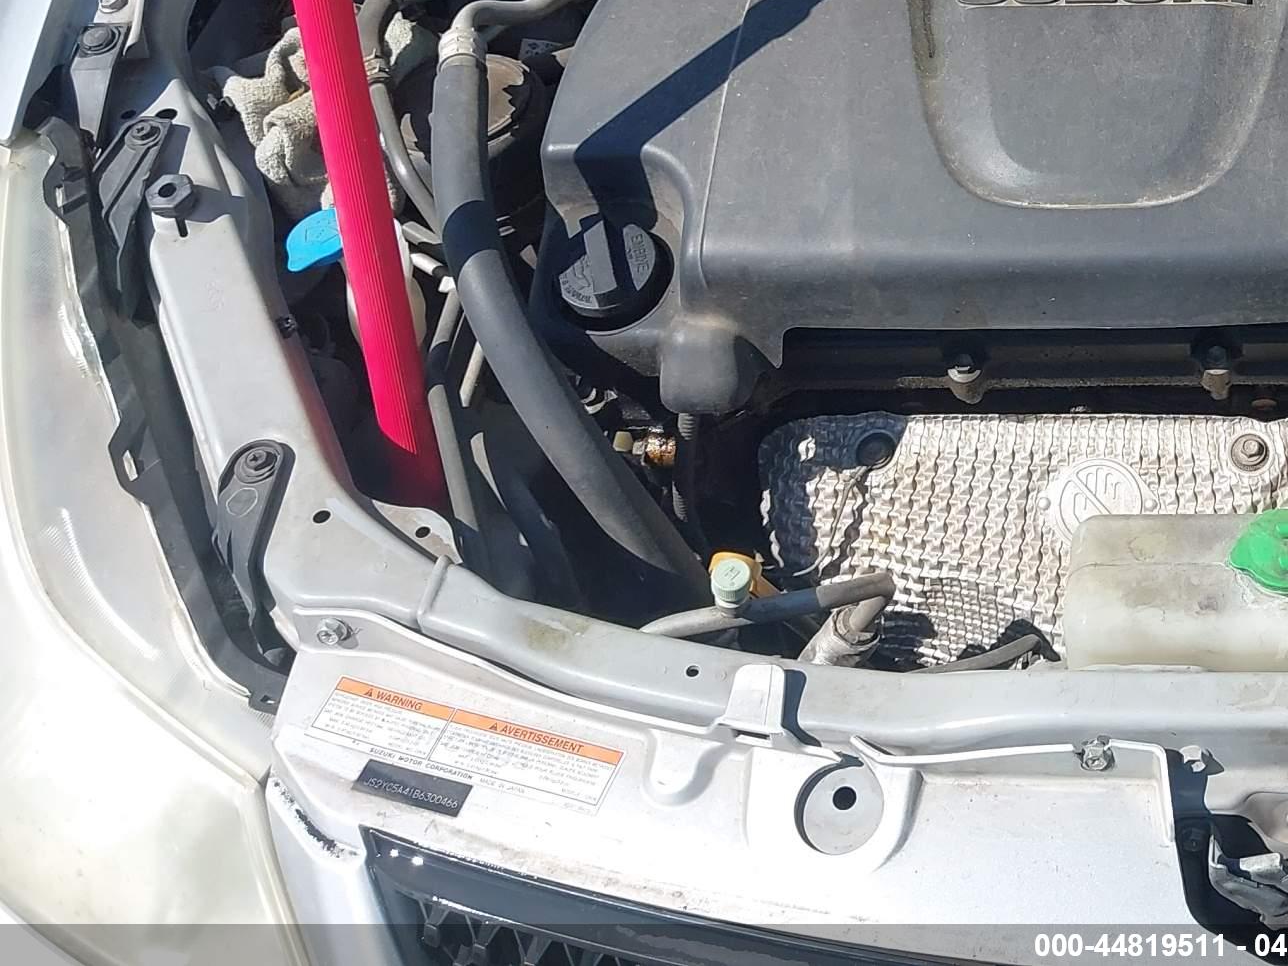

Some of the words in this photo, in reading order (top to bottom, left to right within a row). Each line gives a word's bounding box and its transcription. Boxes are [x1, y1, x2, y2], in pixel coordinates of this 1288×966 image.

[376, 690, 423, 711] WARNING
[500, 725, 585, 753] AVERTISSEMENT
[369, 747, 396, 760] SUZUKI
[398, 756, 423, 766] MOTOR
[425, 762, 473, 780] CORPORATION
